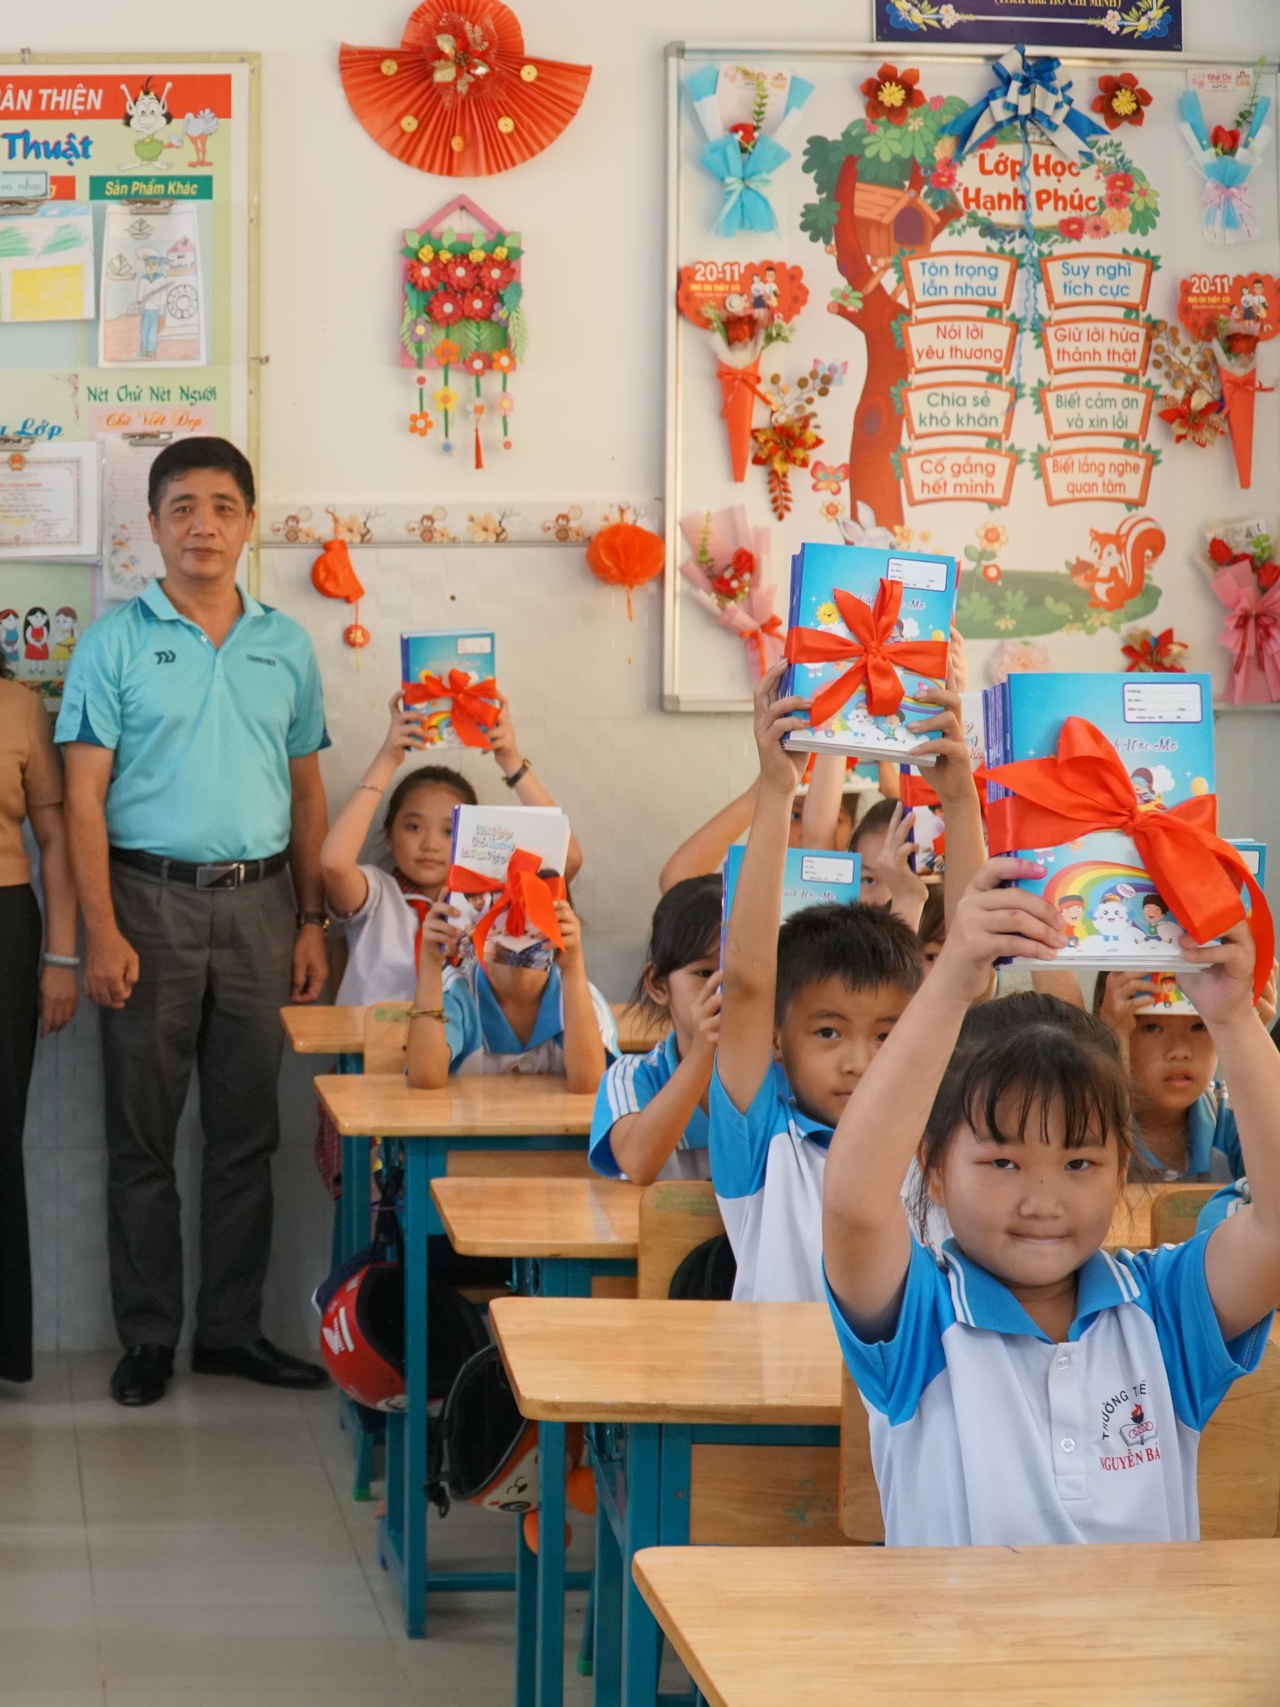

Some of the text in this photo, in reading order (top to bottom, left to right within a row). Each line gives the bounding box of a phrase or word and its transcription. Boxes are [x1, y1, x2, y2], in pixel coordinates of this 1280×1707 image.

[38, 83, 103, 116] THIỆN
[0, 129, 93, 167] Thuật
[978, 152, 1081, 180] Lớp Học
[105, 180, 198, 198] Sản Phẩm Khác
[962, 186, 1099, 216] Hạnh Phúc
[694, 263, 740, 282] 20-11
[920, 261, 1000, 281] Tôn trọng
[1061, 261, 1132, 280] Suy nghĩ
[921, 278, 997, 297] lẫn nhau
[1062, 280, 1131, 299] tích cực
[1191, 275, 1230, 293] 20-11
[936, 324, 984, 340] Nói lời
[1053, 327, 1140, 343] Giữ lời hứa
[916, 347, 1003, 363] yêu thương
[1057, 347, 1137, 367] thành thật
[87, 384, 218, 406] Nét Chữ Nét Người
[927, 391, 991, 408] Chia sẻ
[1055, 393, 1139, 410] Biết cảm ơn
[13, 417, 64, 441] Lớp
[918, 412, 999, 428] khó khăn
[1066, 413, 1128, 429] và xin lỗi
[920, 456, 996, 478] Cố gắng
[1052, 456, 1141, 477] Biết lắng nghe
[920, 477, 995, 495] hết mình
[1067, 480, 1126, 497] quan tâm
[1153, 736, 1179, 752] Mơ
[1099, 1441, 1162, 1472] NGUYỄN BÁ
